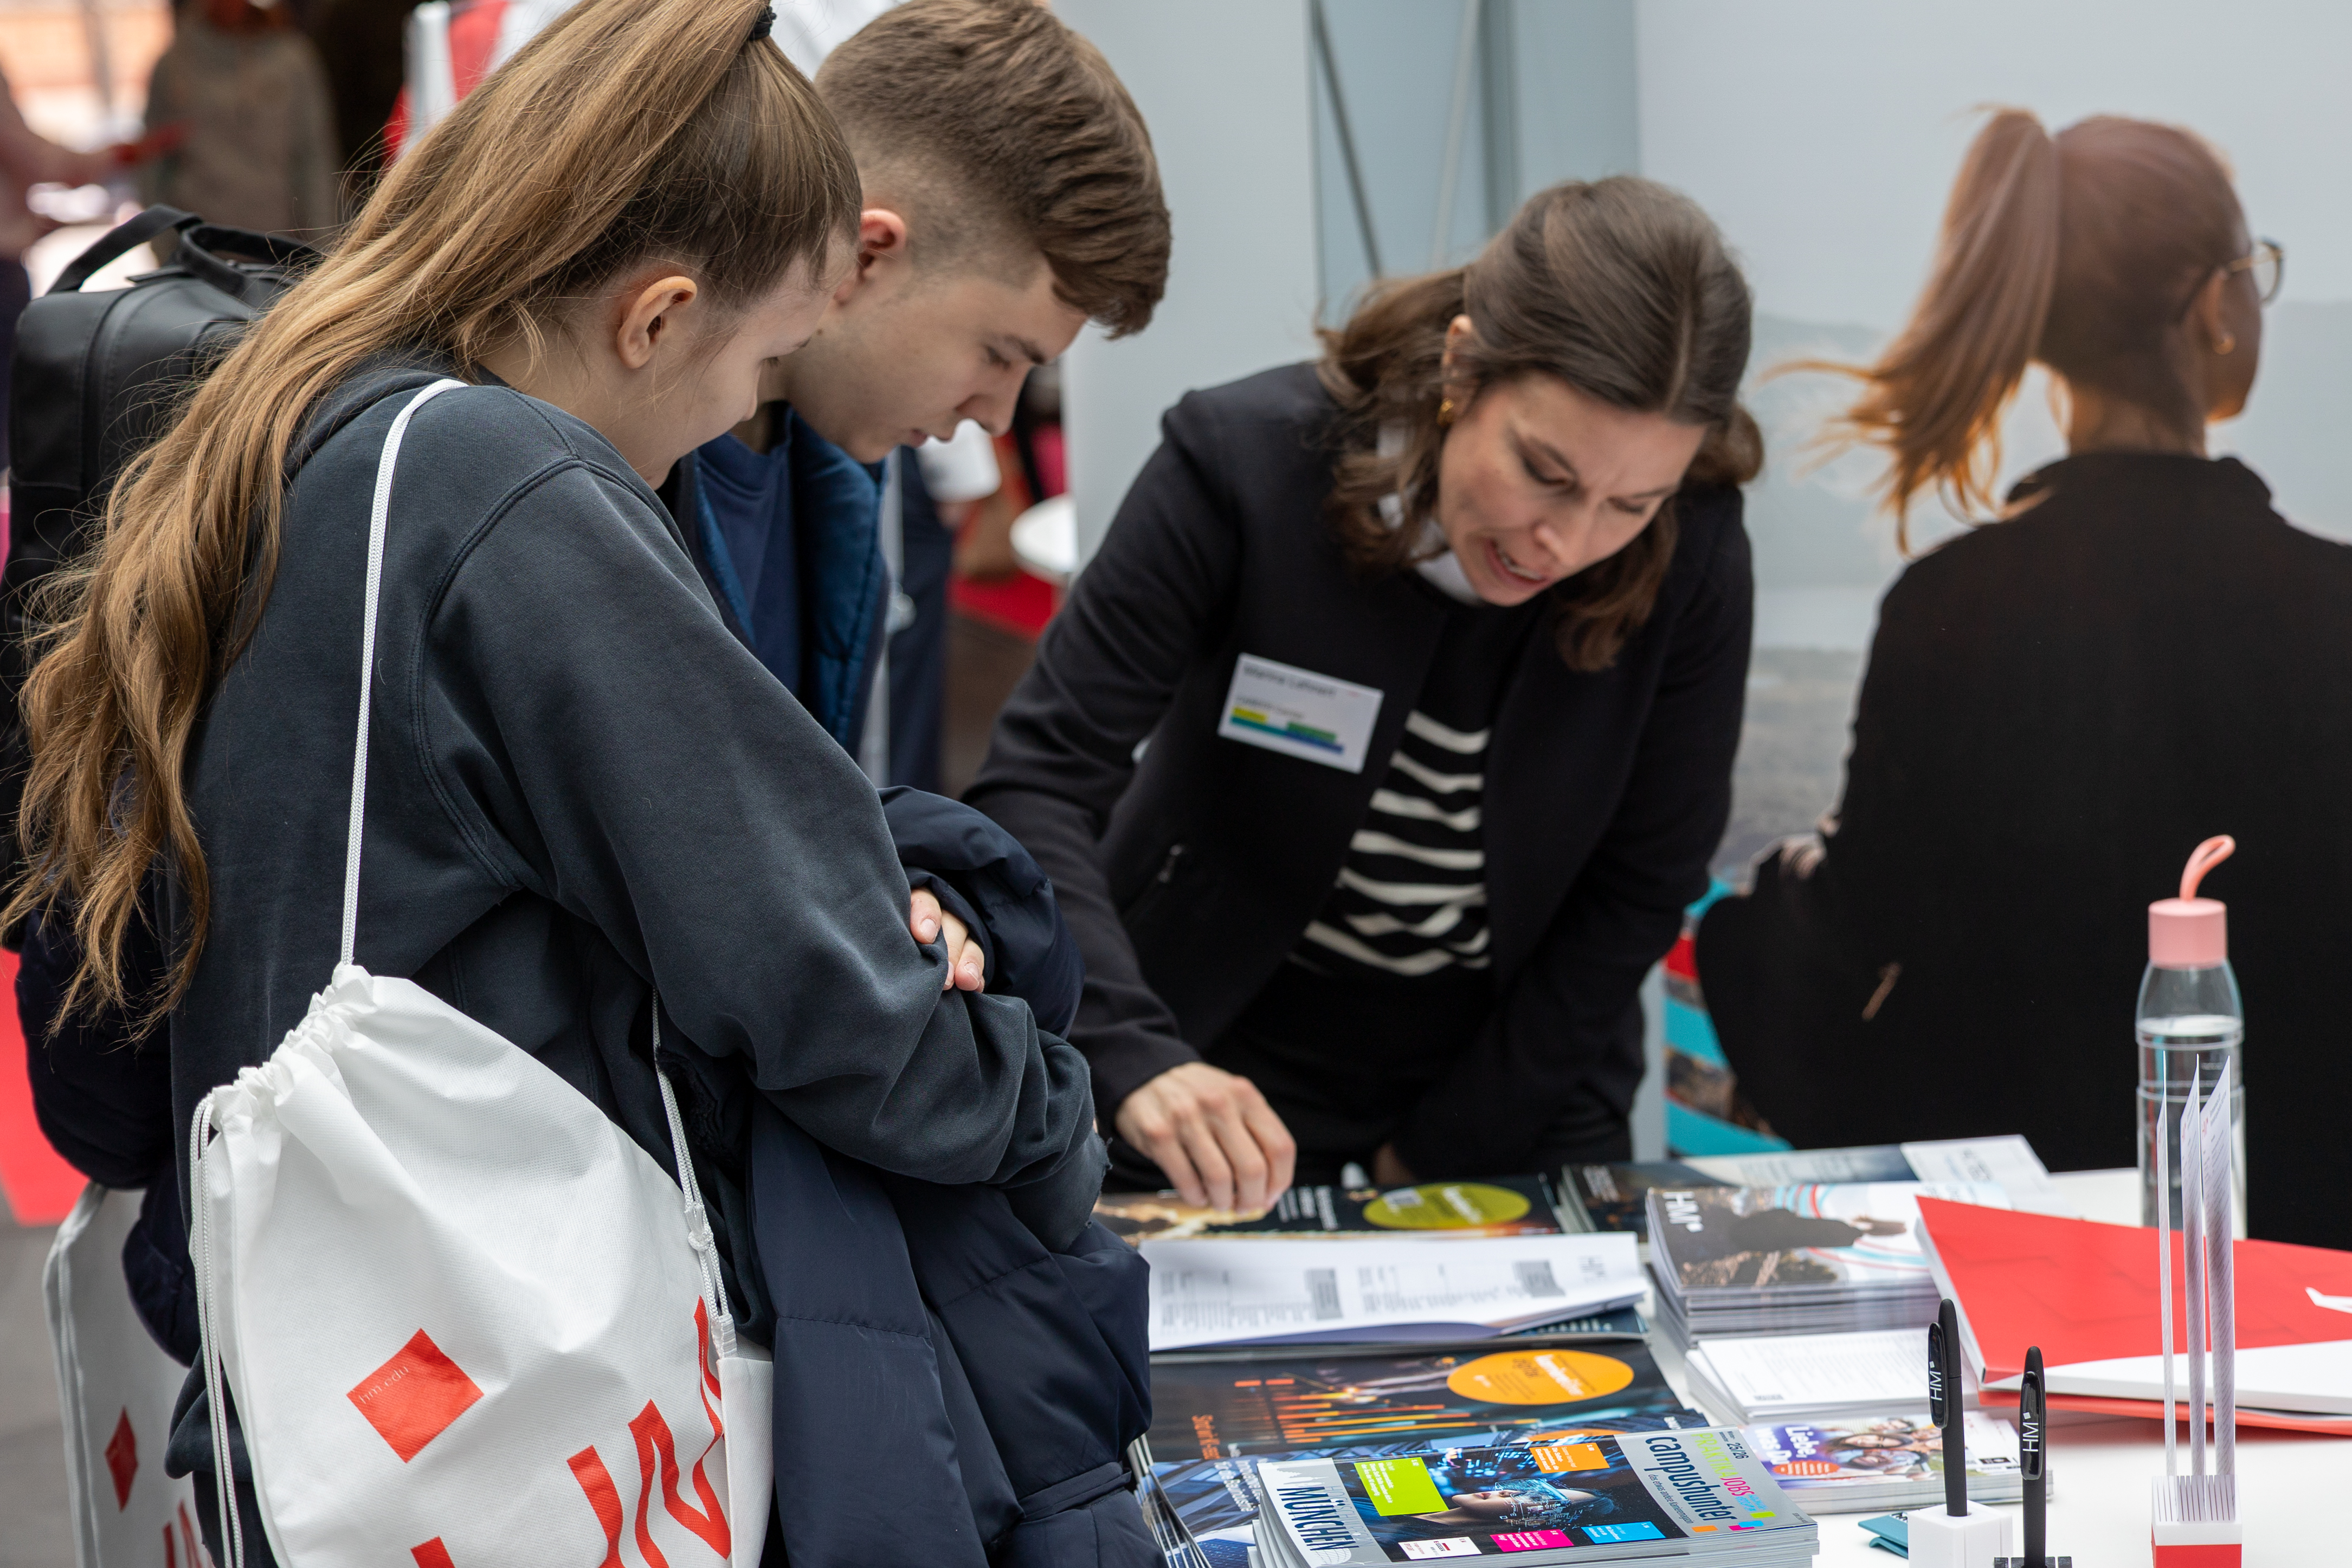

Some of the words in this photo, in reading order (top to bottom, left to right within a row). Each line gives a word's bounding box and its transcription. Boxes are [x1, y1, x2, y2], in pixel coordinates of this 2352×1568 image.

[1662, 1191, 1702, 1224] HM
[358, 1366, 409, 1404] hm.edu
[1929, 1371, 1942, 1401] HM
[1726, 1442, 1749, 1460] 25/26
[2022, 1422, 2039, 1452] HM
[1644, 1436, 1737, 1521] campushunter
[1720, 1476, 1755, 1496] JOBS
[1277, 1486, 1359, 1551] MÜNCHEN
